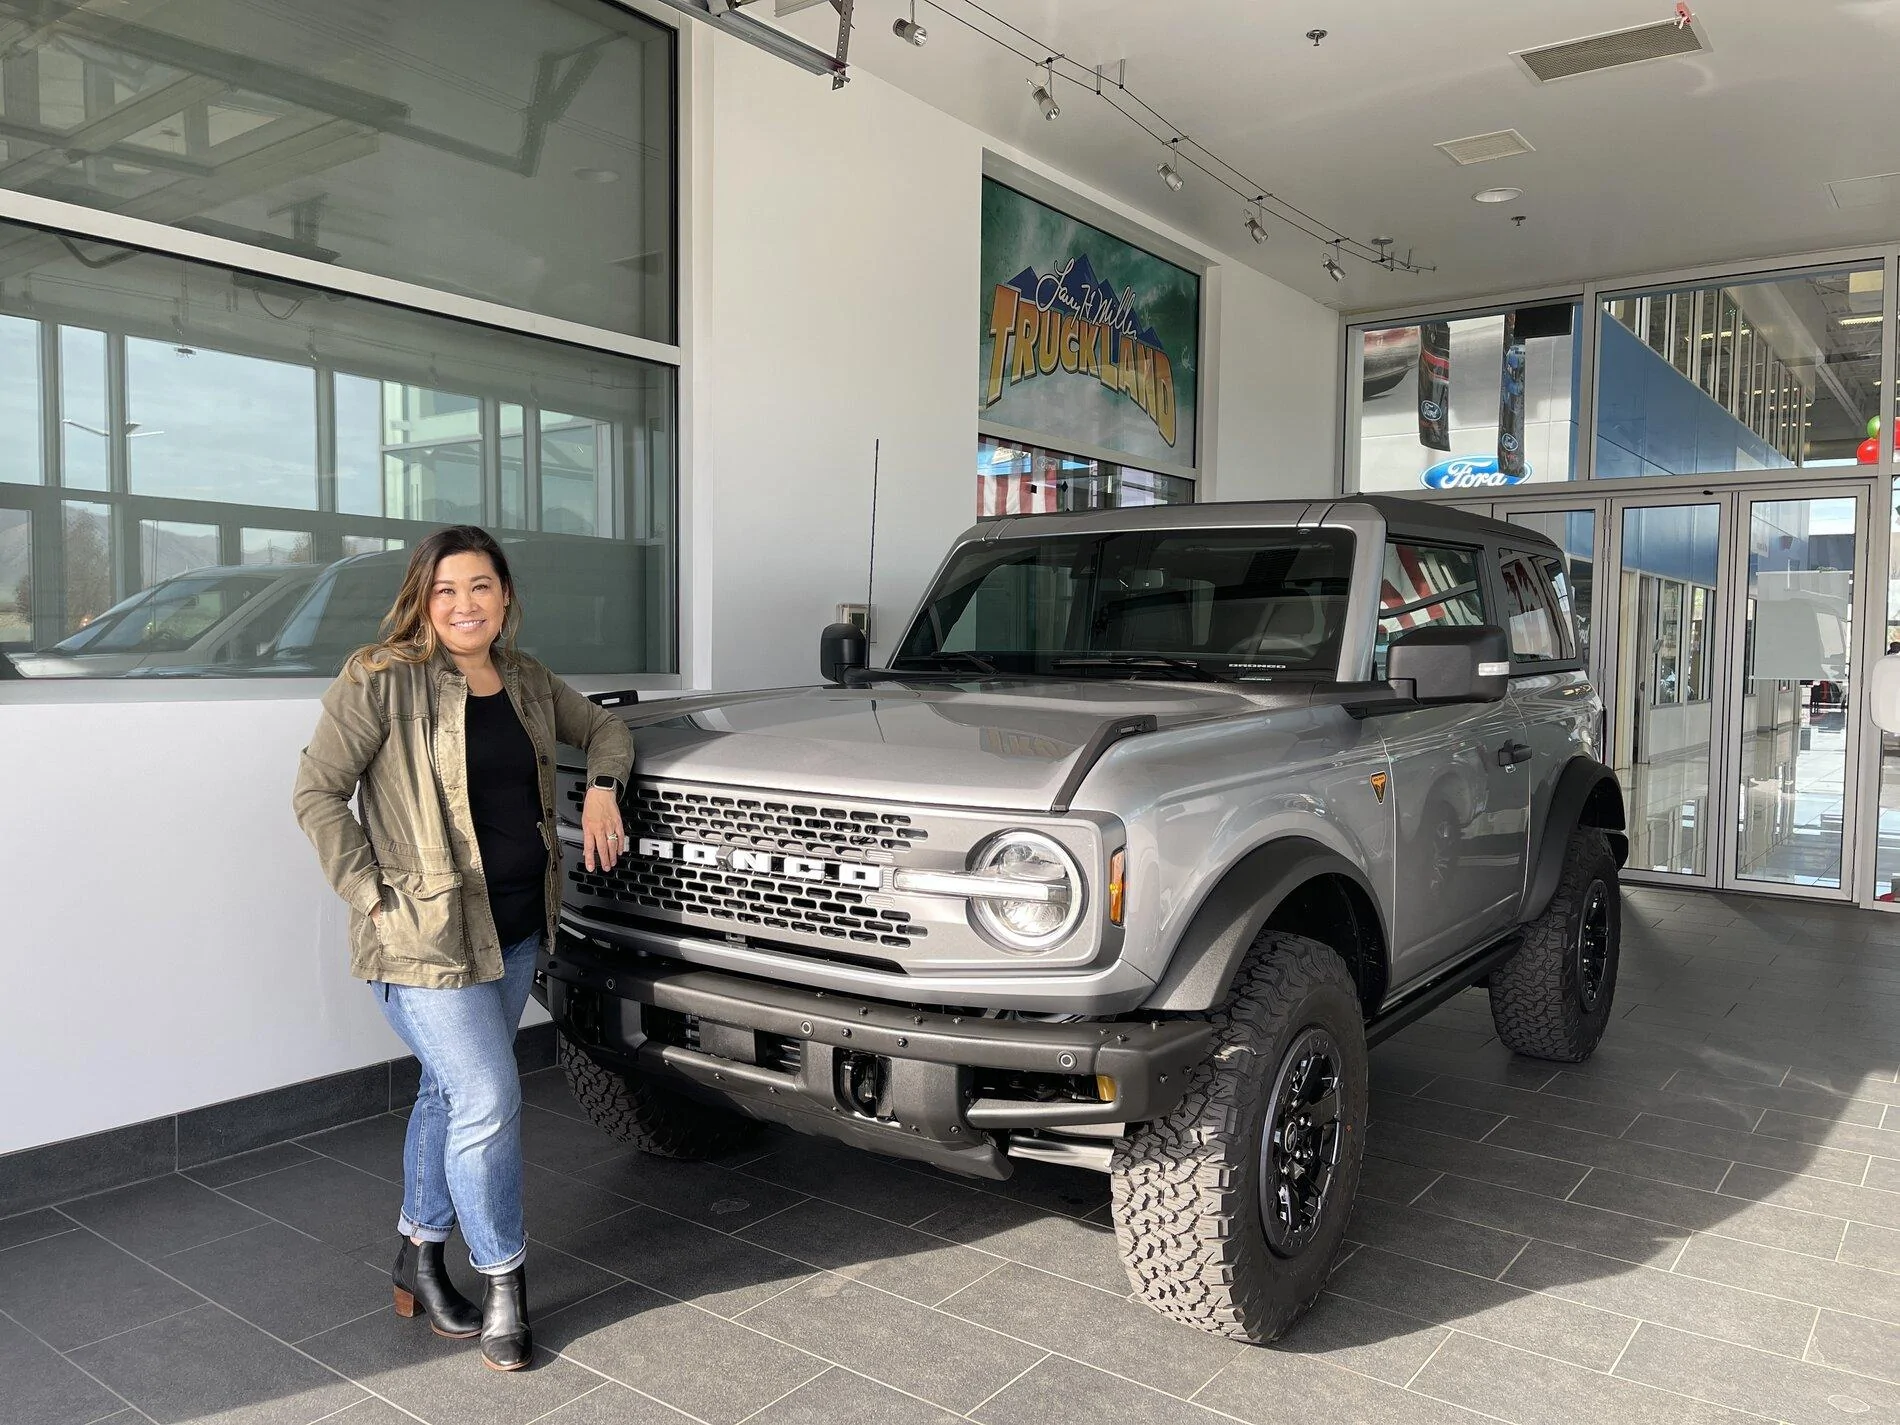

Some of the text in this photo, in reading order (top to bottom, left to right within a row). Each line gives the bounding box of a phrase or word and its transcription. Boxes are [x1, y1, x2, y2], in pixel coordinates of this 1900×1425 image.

[986, 284, 1176, 447] TRUCKLAND
[1424, 402, 1440, 418] Ford
[623, 836, 883, 888] RONCO
